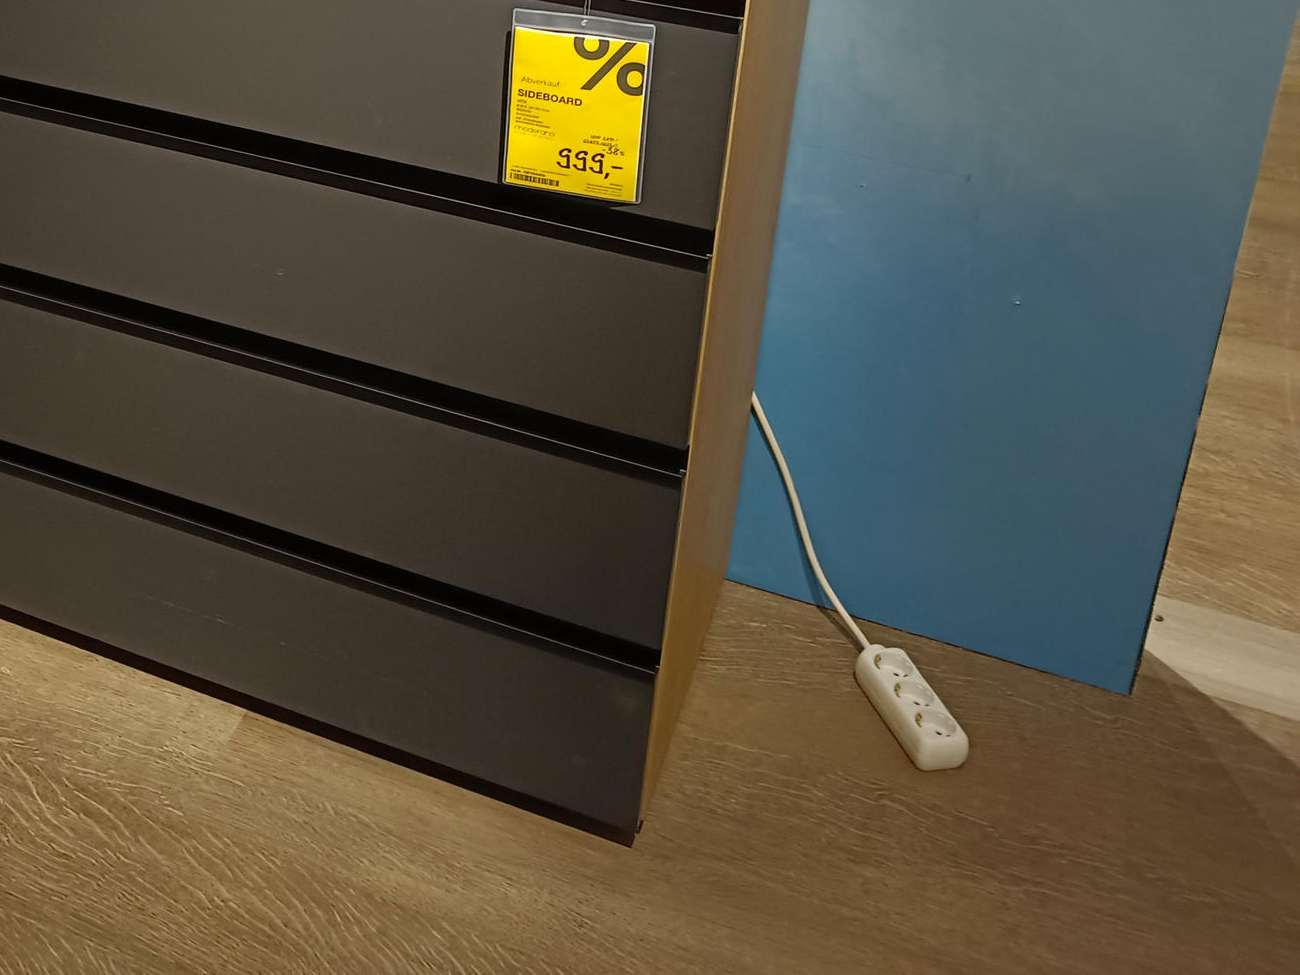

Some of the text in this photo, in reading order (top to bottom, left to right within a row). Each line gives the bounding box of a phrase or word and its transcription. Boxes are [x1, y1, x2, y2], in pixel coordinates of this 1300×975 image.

[521, 76, 561, 88] Abverkauf
[517, 88, 583, 107] SIDEBOARD
[556, 147, 624, 180] 999,-
